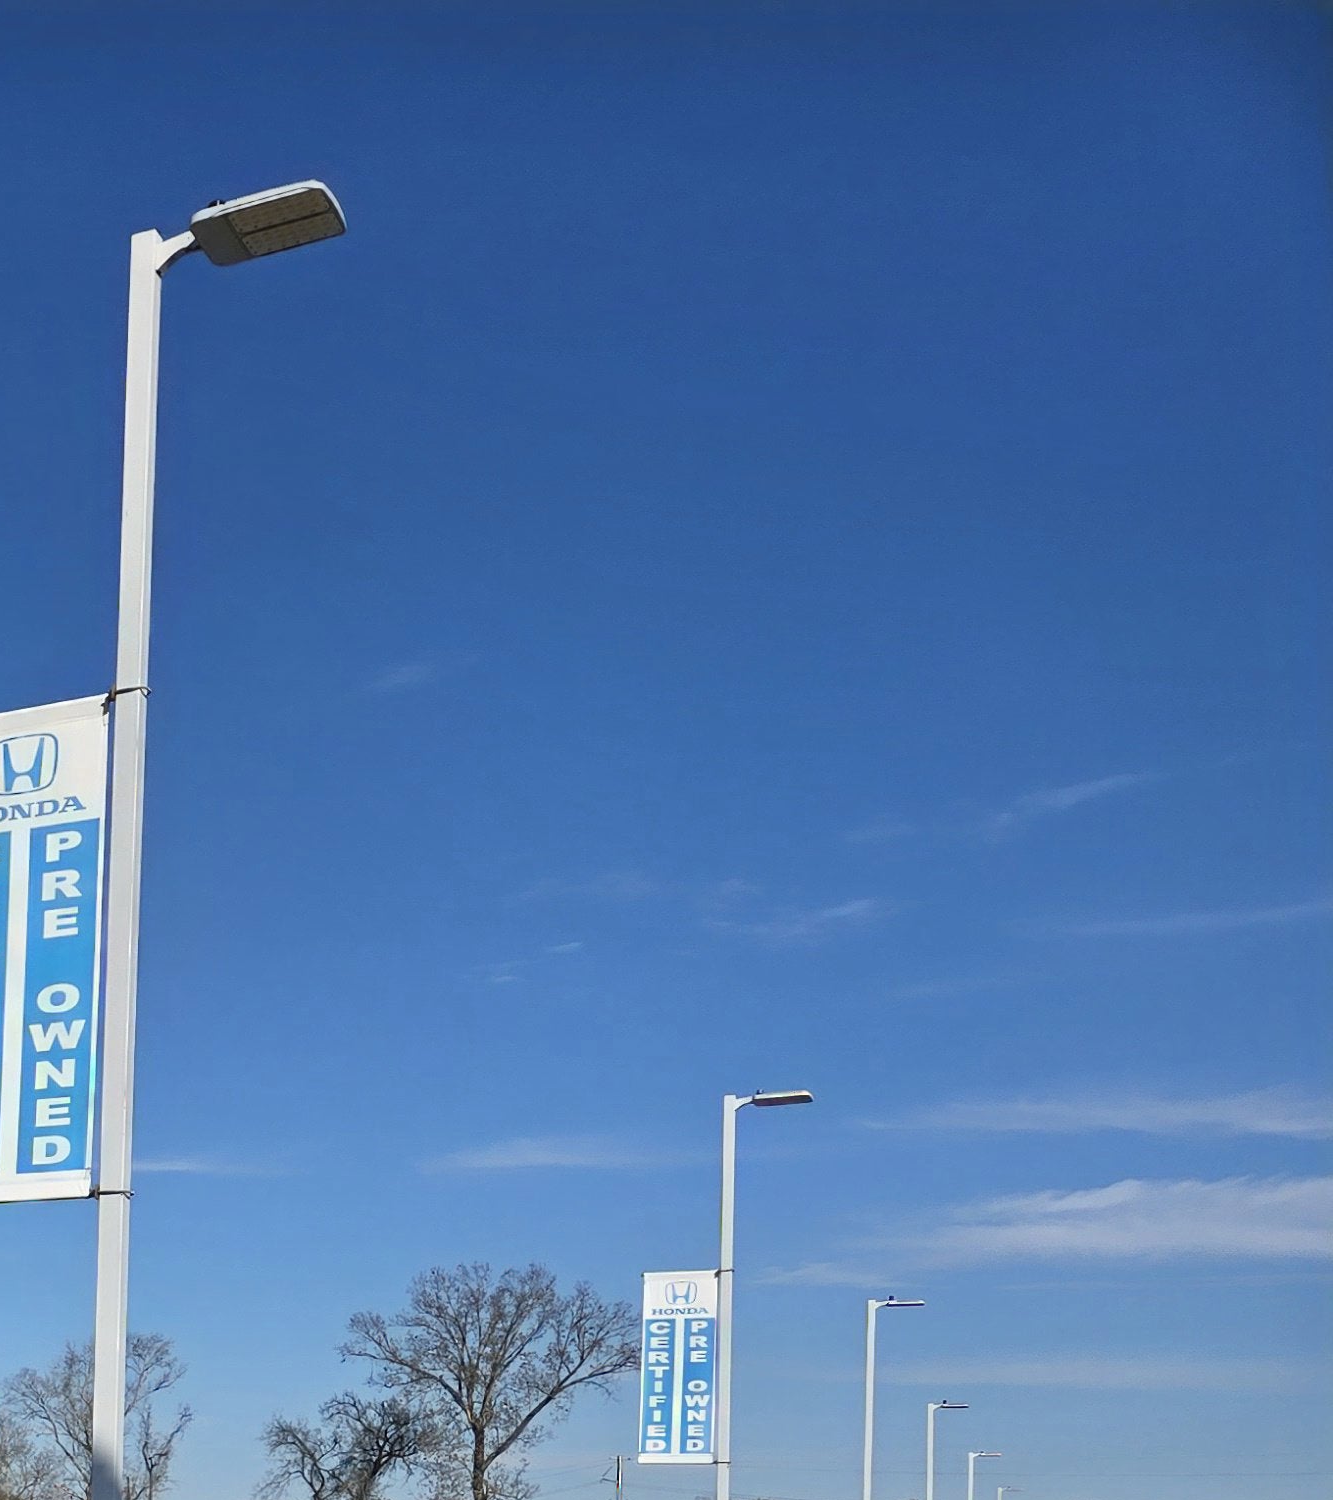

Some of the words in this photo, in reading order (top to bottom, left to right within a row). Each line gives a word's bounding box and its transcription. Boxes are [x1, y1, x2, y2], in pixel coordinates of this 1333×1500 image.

[42, 830, 83, 940] PRE
[28, 982, 86, 1166] OWNED
[651, 1307, 709, 1316] HONDA
[689, 1320, 709, 1363] PRE
[645, 1321, 671, 1452] CERTIFIED
[684, 1379, 710, 1451] OWNED
